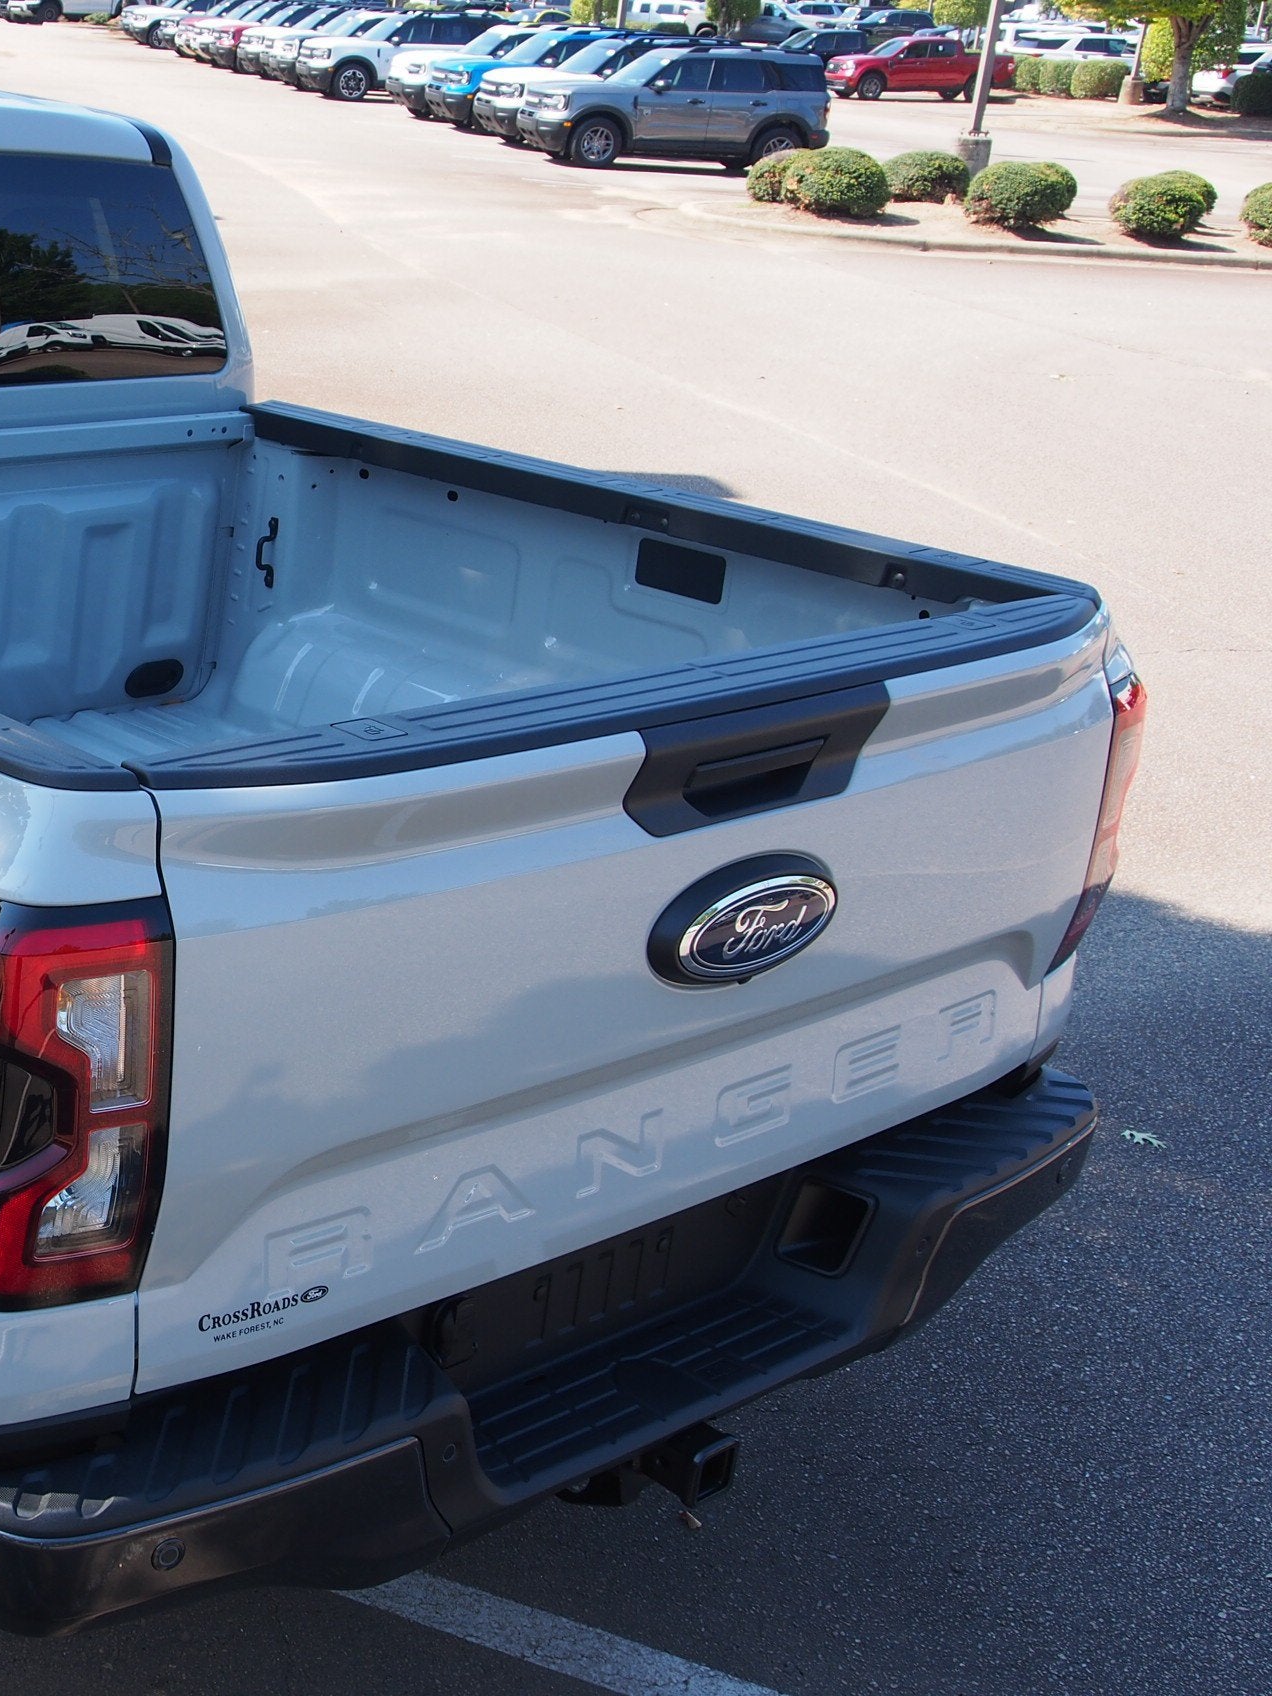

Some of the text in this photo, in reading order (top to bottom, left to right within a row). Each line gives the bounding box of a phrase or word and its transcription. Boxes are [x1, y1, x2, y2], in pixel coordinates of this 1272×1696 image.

[722, 898, 808, 961] Ford
[262, 987, 997, 1298] RANGER
[213, 1330, 237, 1343] WAKE
[273, 1316, 285, 1330] NC
